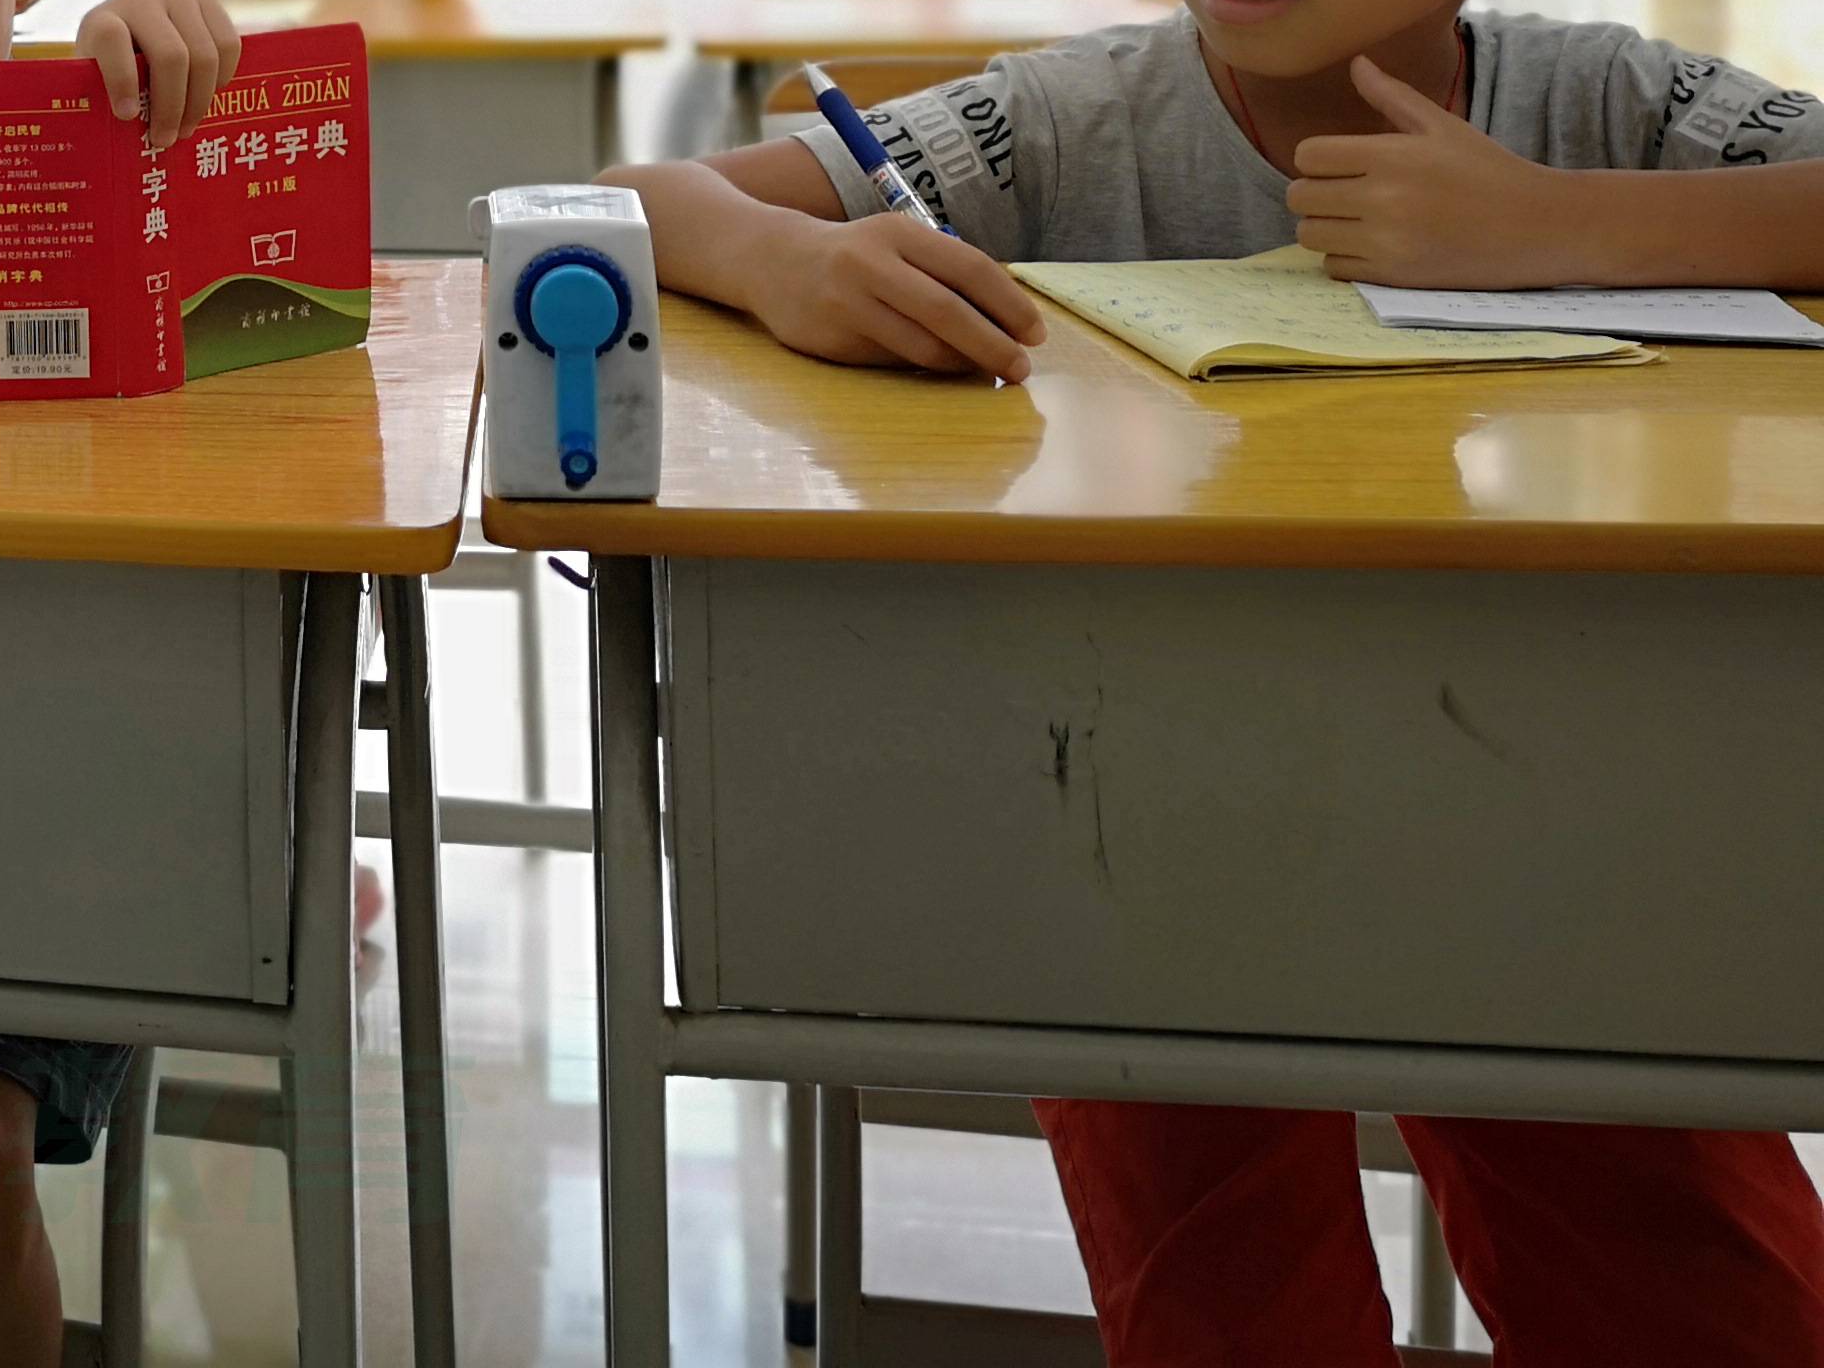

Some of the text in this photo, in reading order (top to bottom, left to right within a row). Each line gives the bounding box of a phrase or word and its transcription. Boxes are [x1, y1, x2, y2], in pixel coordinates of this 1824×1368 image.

[196, 120, 348, 178] 新华字典
[900, 96, 976, 179] GOOD
[247, 176, 297, 199] 第11版
